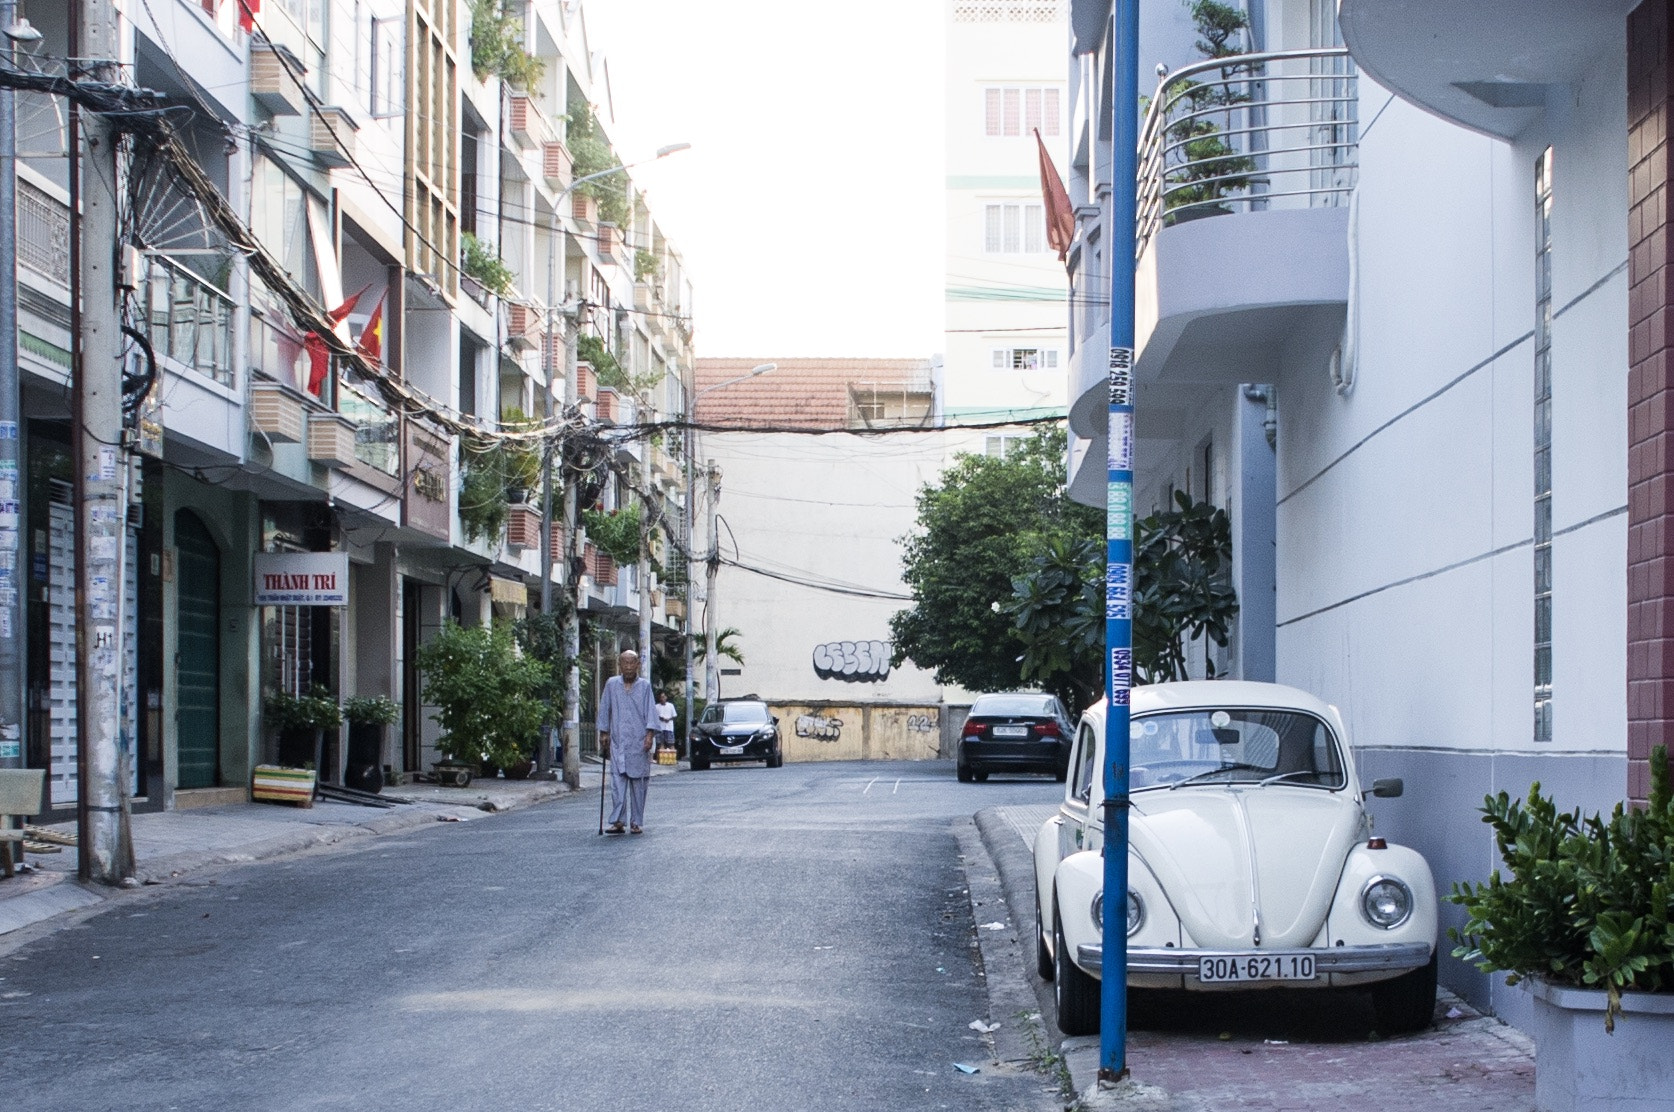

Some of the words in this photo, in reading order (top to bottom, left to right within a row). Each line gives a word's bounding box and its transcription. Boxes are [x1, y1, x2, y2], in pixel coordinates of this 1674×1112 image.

[263, 570, 309, 590] THÀNH
[312, 571, 336, 590] TRÍ
[1203, 956, 1312, 979] 30A-621.10
